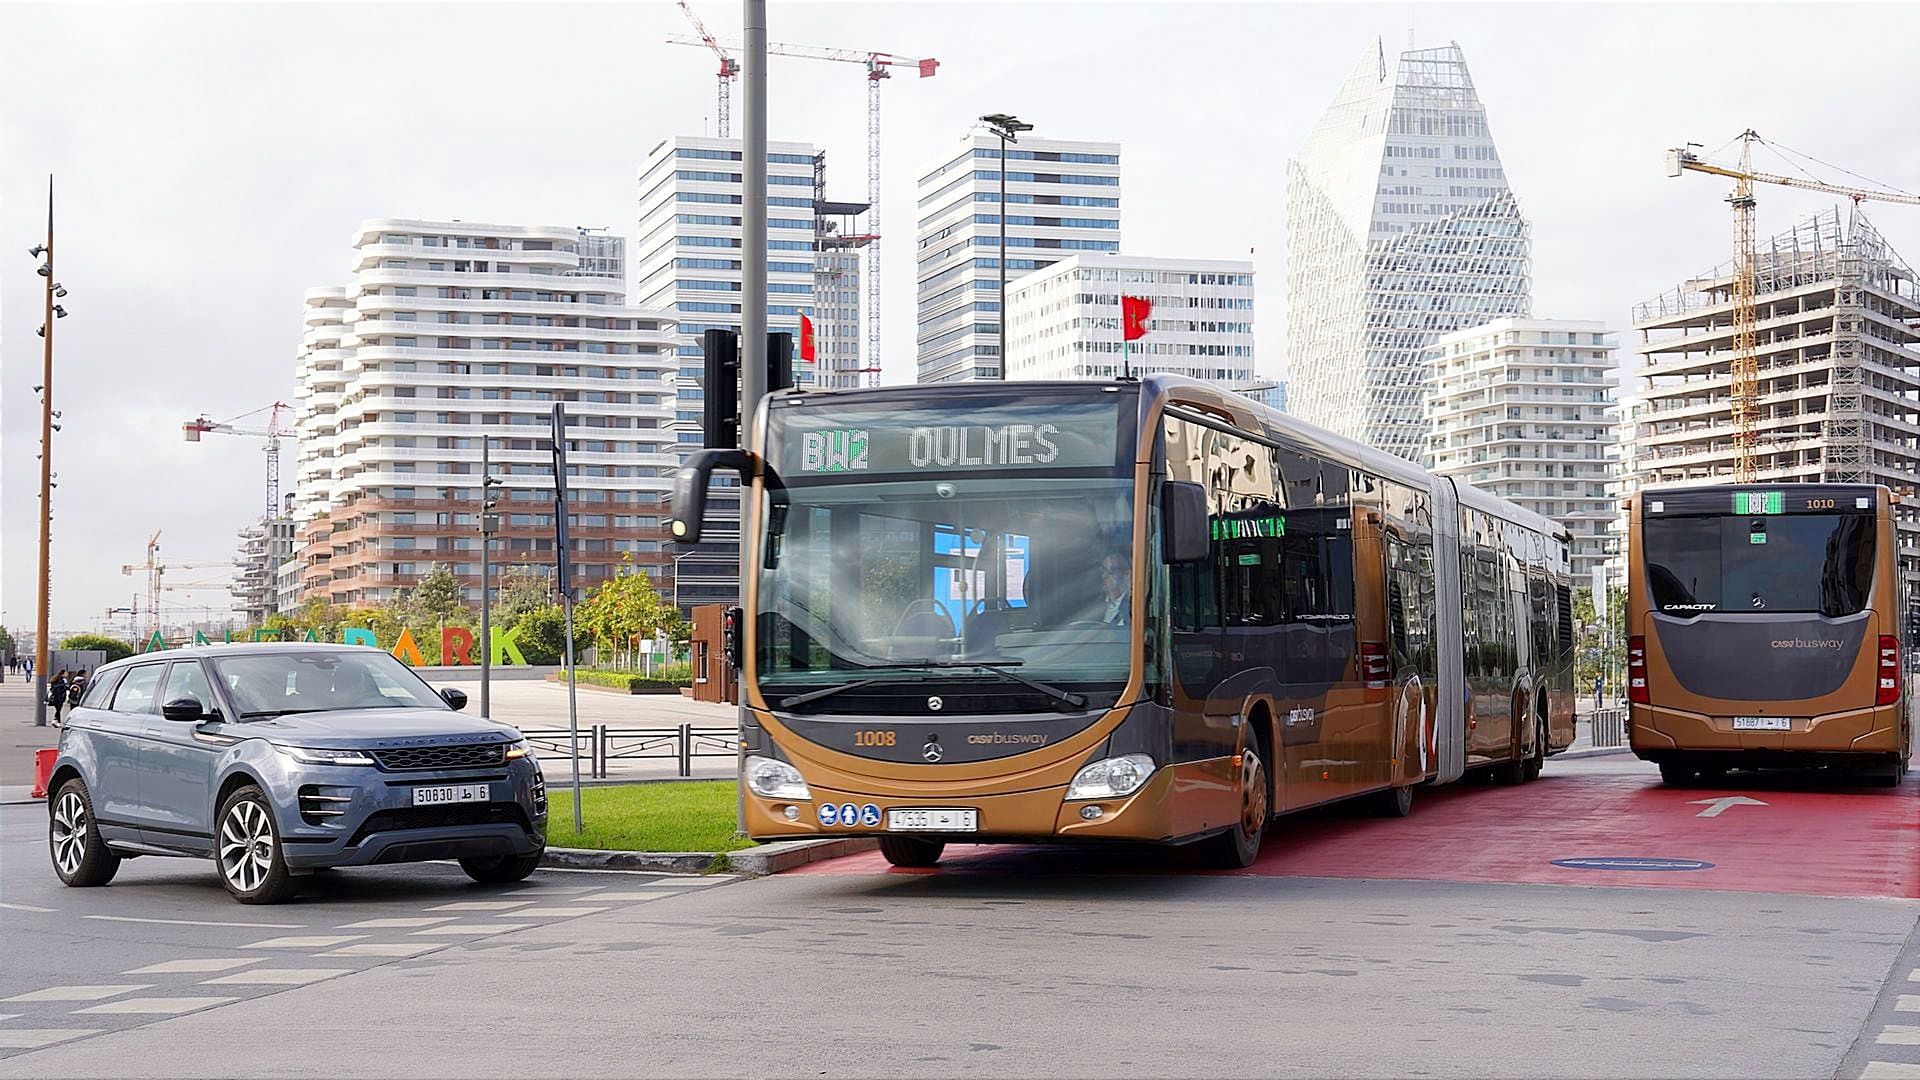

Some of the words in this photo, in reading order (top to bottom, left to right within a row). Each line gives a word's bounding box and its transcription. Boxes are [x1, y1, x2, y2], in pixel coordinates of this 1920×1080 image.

[801, 429, 869, 472] BW2
[909, 423, 1060, 467] OULMES
[1807, 499, 1835, 509] 1010
[1781, 718, 1787, 727] 6
[854, 731, 897, 747] 1008
[418, 788, 453, 803] 50830
[461, 788, 472, 800] ط
[480, 786, 486, 799] 6
[964, 811, 971, 827] 6
